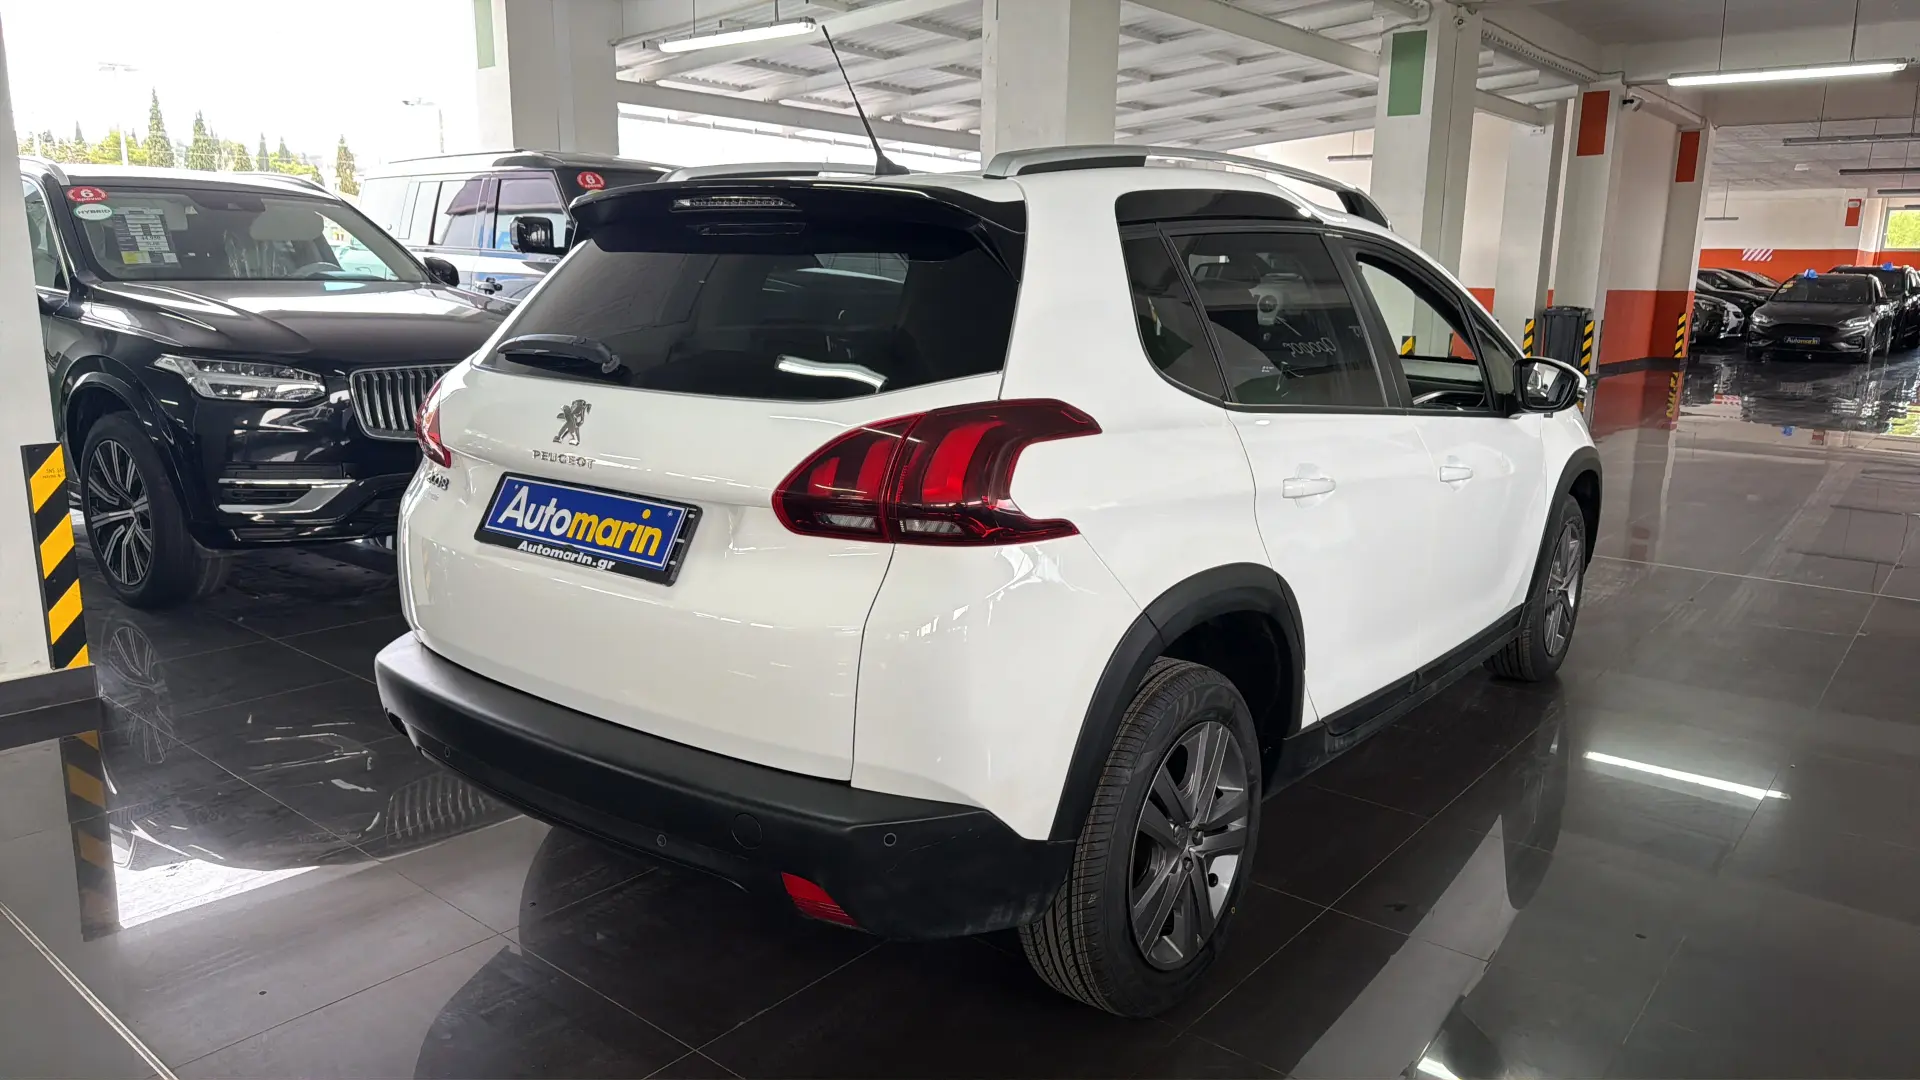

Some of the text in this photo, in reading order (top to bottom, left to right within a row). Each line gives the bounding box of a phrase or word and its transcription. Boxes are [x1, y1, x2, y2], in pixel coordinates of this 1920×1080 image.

[585, 174, 596, 185] 6
[80, 188, 94, 198] 6
[532, 449, 596, 470] PEUGEOT
[497, 485, 663, 557] Automarin
[517, 540, 616, 571] Automarin.gr
